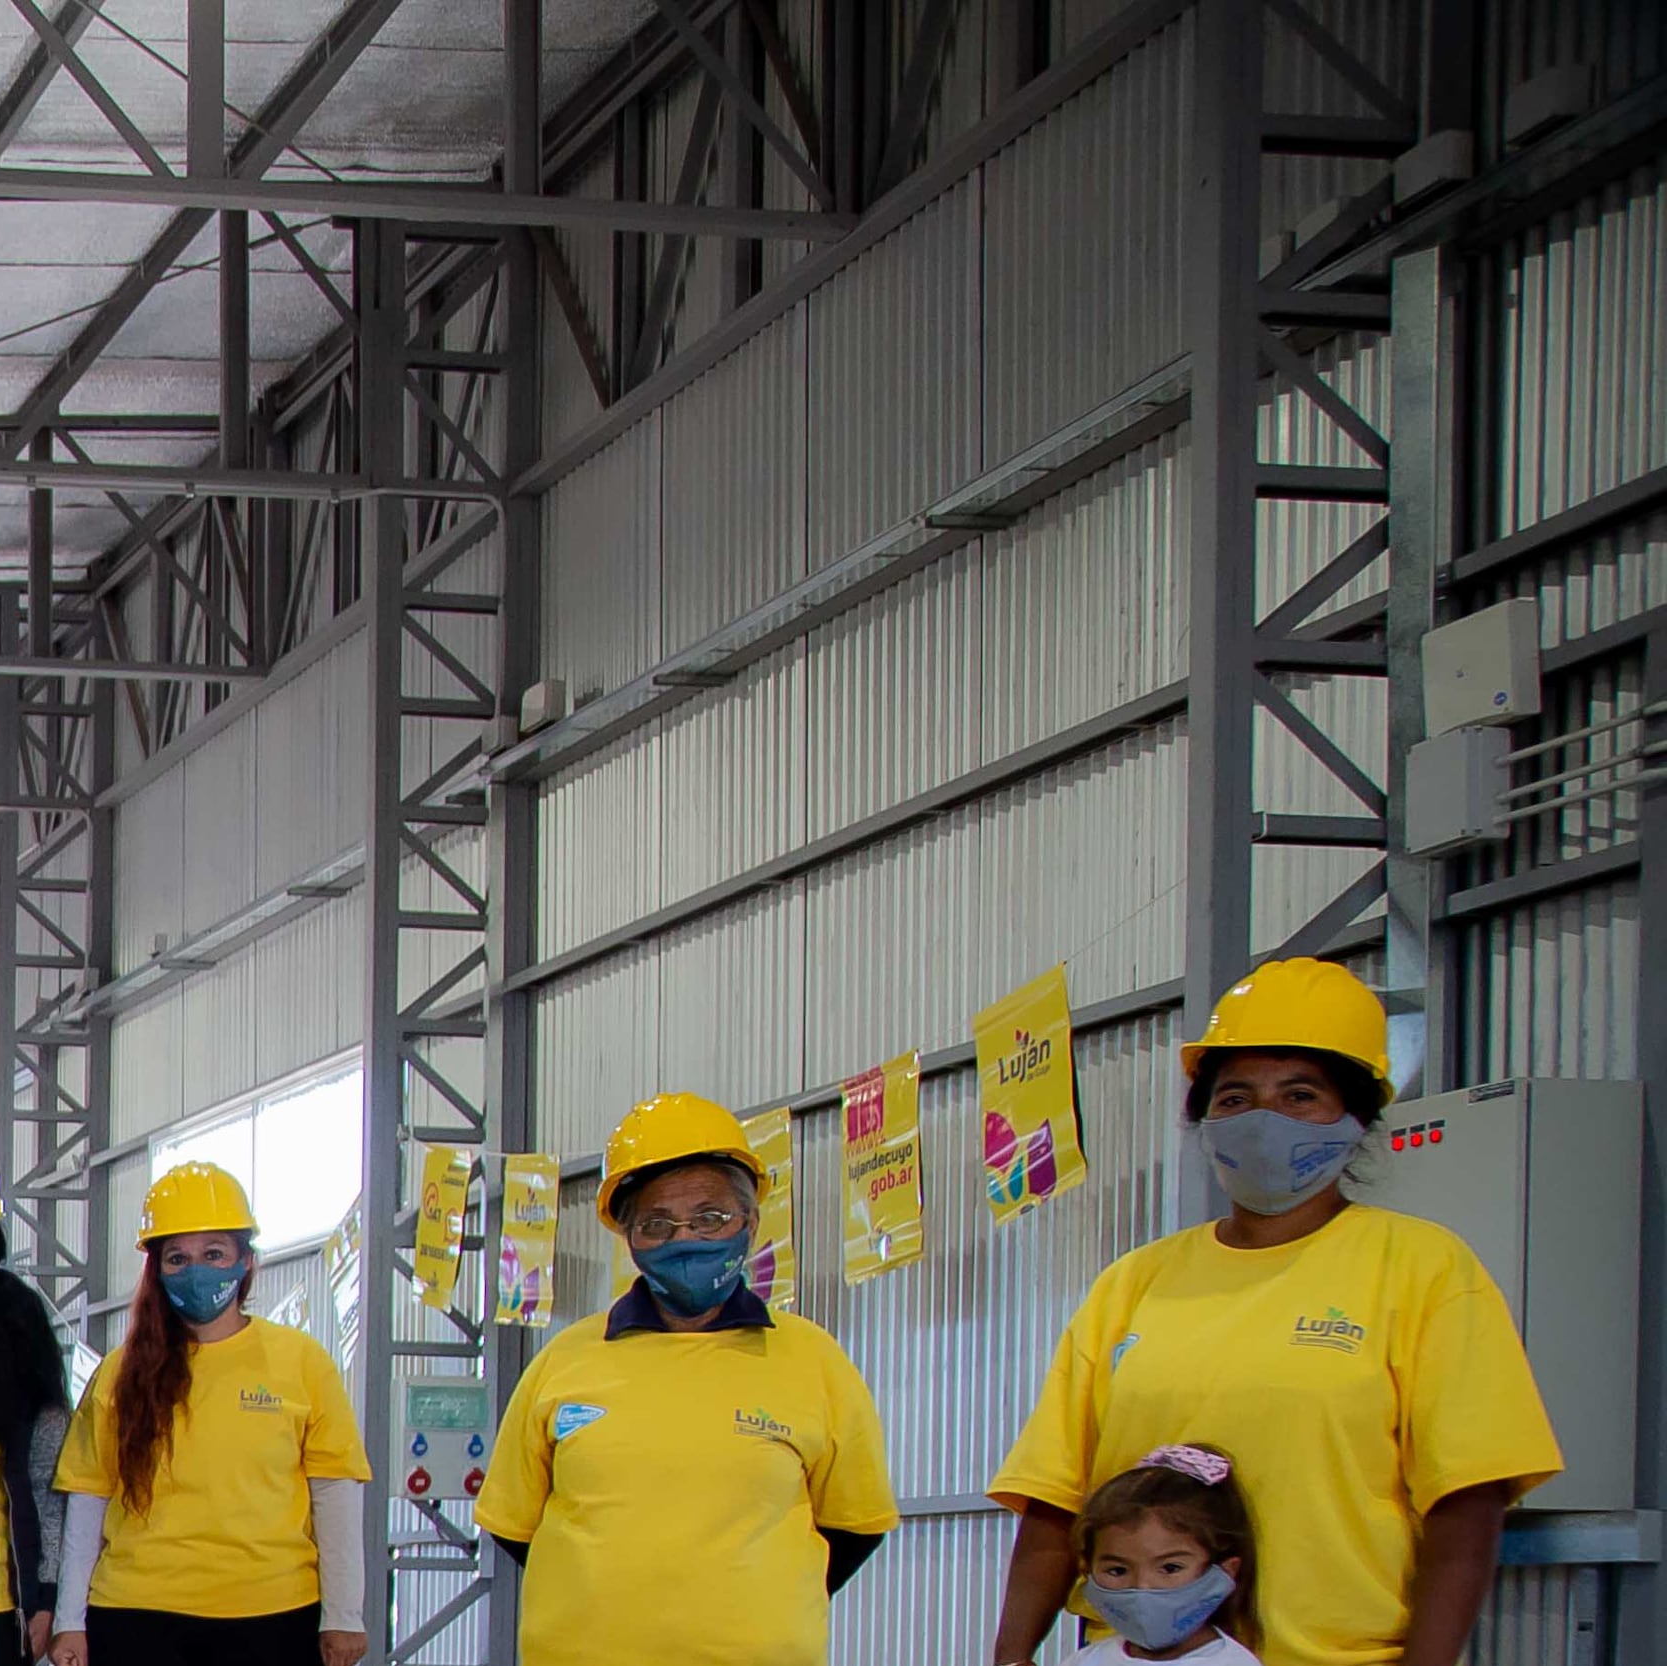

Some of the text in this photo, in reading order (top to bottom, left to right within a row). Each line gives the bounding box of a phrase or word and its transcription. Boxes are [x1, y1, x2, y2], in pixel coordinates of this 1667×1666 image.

[998, 1038, 1051, 1085] Luján
[848, 1143, 913, 1182] lujandecuyo
[868, 1166, 914, 1201] .gob.ar
[1295, 1315, 1365, 1341] Luján
[240, 1388, 283, 1406] Luján
[735, 1408, 792, 1436] Luján
